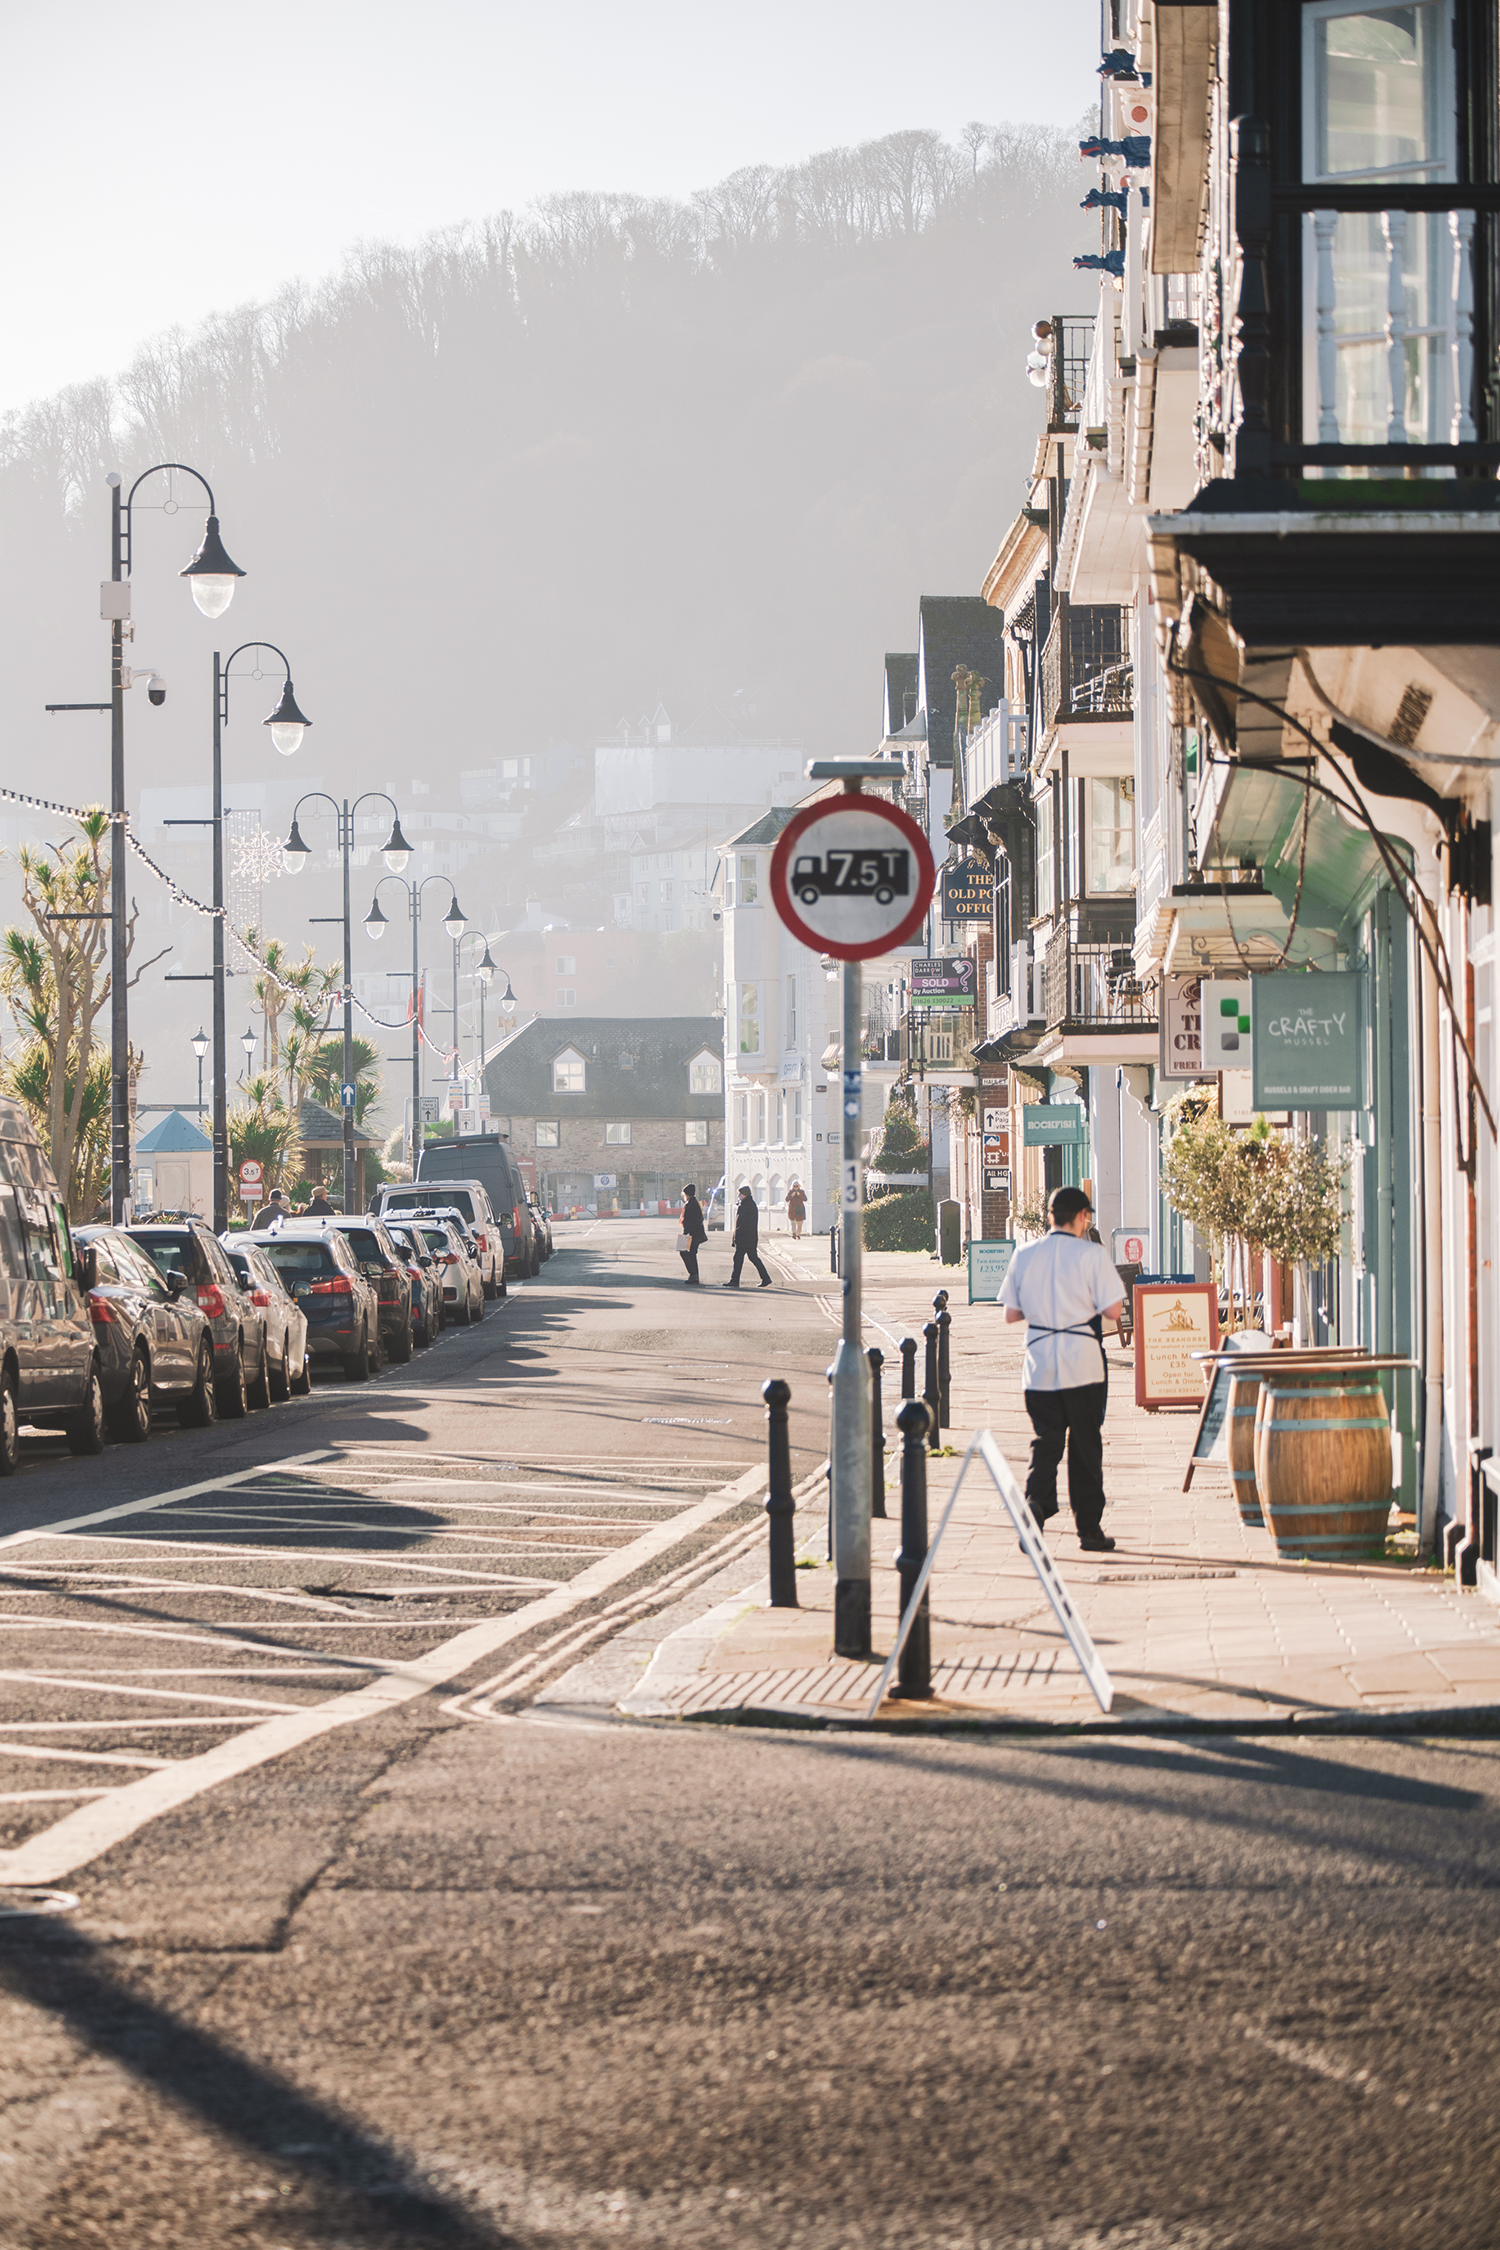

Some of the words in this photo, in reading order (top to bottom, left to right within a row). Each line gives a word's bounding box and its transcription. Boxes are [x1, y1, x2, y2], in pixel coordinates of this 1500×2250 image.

[966, 874, 994, 885] THE
[948, 888, 976, 899] OLD
[914, 967, 941, 975] DARROW
[921, 978, 949, 987] SOLD
[1298, 1008, 1313, 1016] THE
[1268, 1012, 1346, 1036] CRAFTY
[1284, 1037, 1329, 1046] MUSSEL
[1173, 1062, 1198, 1070] FREE
[1298, 1085, 1319, 1094] CRAFT
[1319, 1085, 1338, 1094] CIDER
[1338, 1085, 1351, 1094] BAR
[1027, 1120, 1077, 1130] ROCKFISH
[1169, 1361, 1186, 1369] £35
